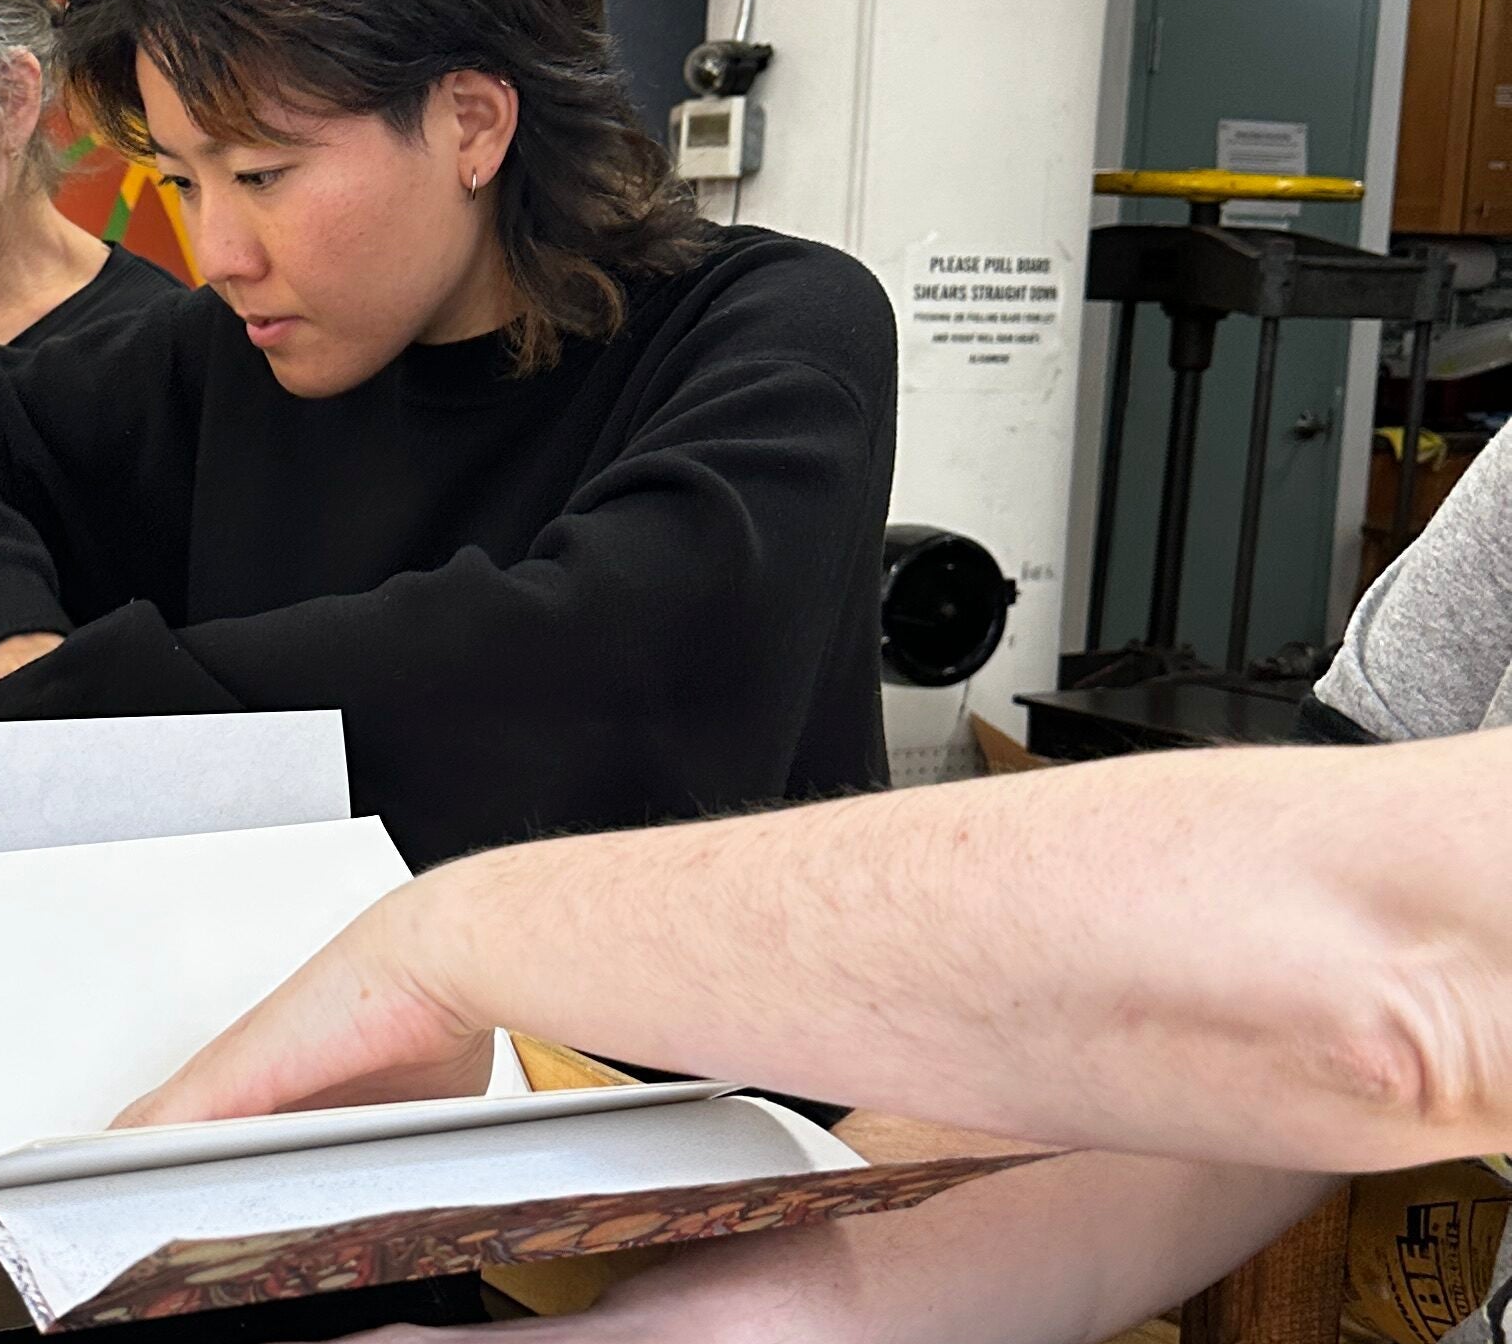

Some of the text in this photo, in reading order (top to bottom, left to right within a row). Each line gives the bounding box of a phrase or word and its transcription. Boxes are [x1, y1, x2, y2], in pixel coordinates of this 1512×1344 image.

[929, 255, 981, 273] PLEASE
[983, 256, 1013, 273] PULL
[913, 283, 967, 301] SHEARS
[970, 284, 1026, 301] STRAIGHT
